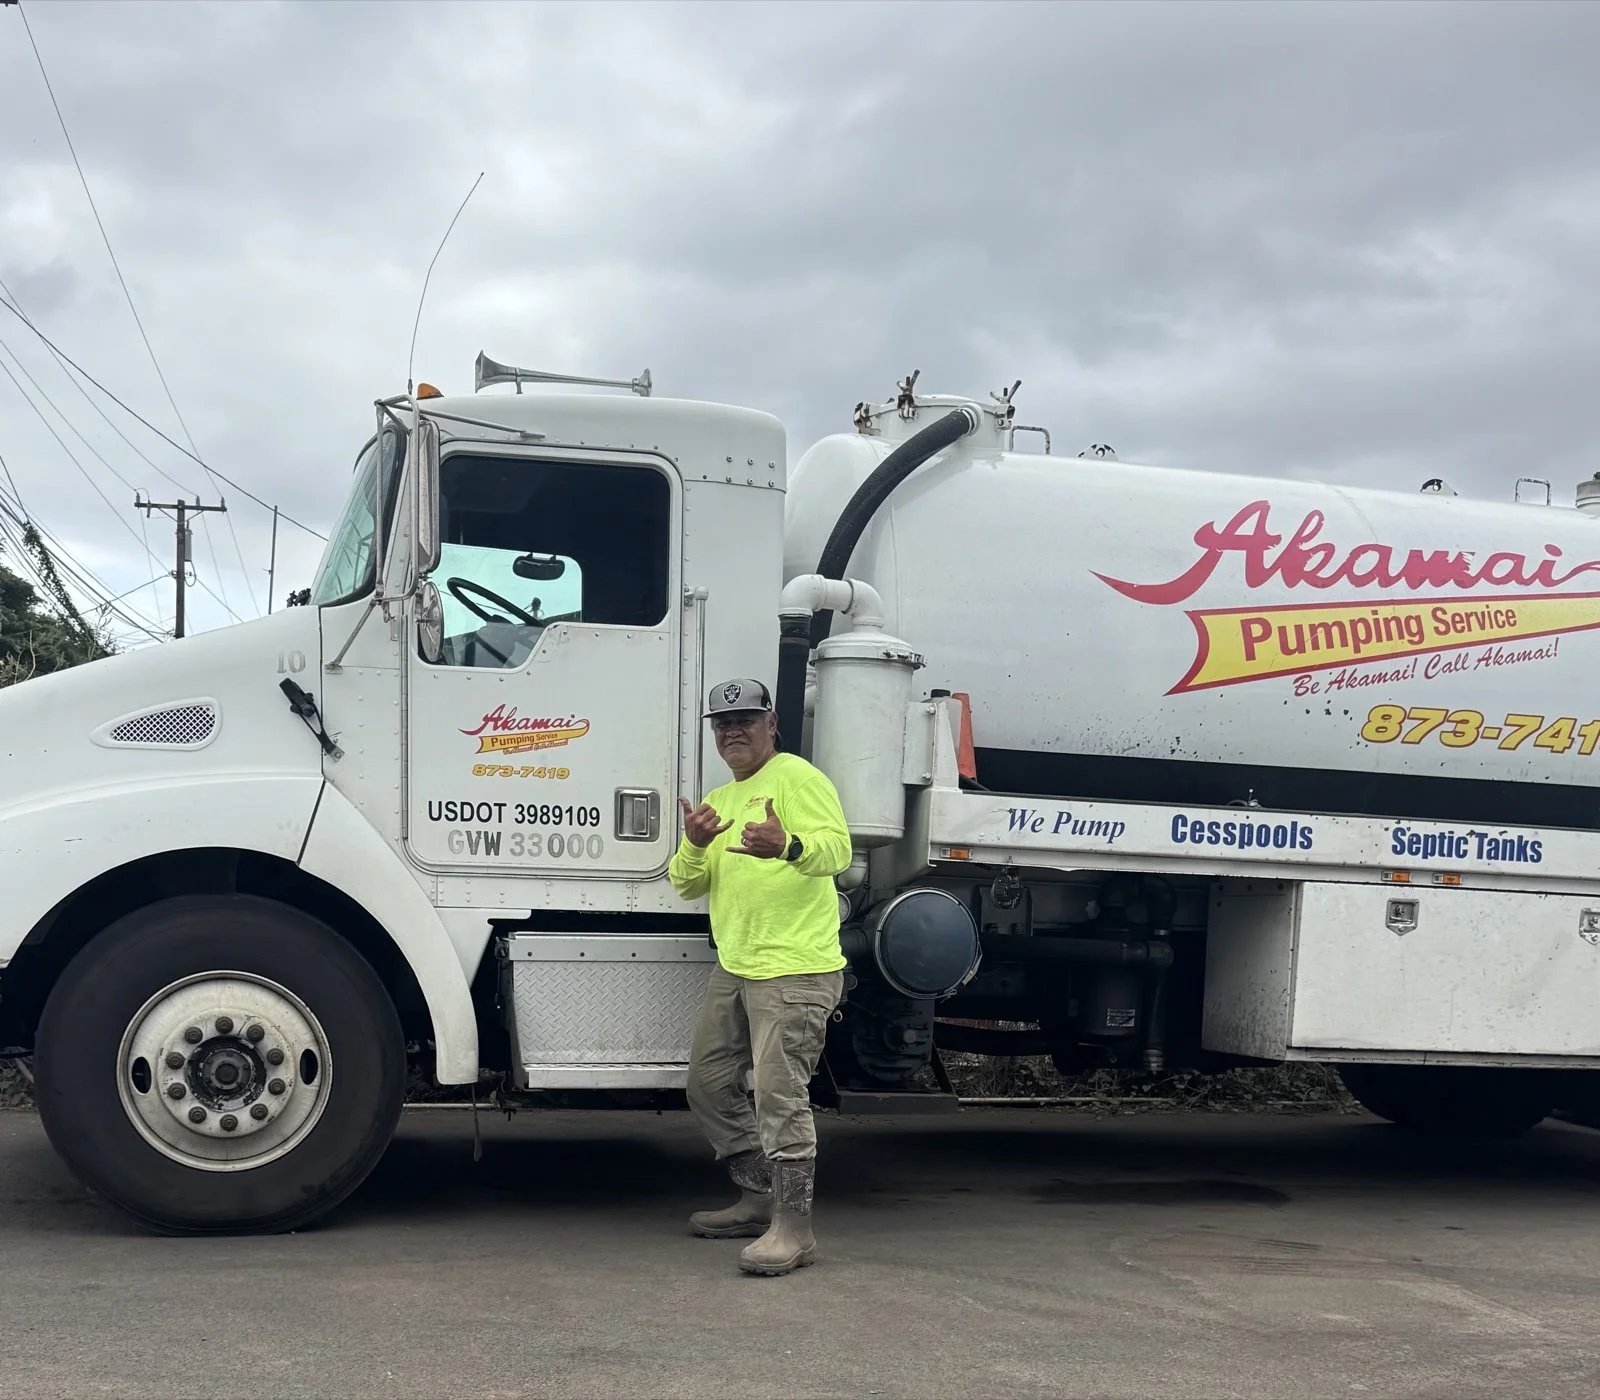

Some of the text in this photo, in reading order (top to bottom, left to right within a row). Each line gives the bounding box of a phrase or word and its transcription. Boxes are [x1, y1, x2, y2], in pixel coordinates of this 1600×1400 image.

[1089, 499, 1582, 605] Akamai
[1240, 604, 1518, 662] Pumping Service
[276, 650, 306, 674] 10
[1293, 637, 1560, 697] Be Akamai! Call Akamai!
[457, 703, 577, 736] Akamai
[1361, 704, 1600, 756] 873-741
[491, 734, 535, 747] Pumping
[536, 733, 559, 742] Service
[472, 764, 571, 780] 873-7419
[428, 800, 601, 827] USDOT 3989109
[447, 829, 605, 860] GVW 33000
[1007, 808, 1543, 864] We Pump Cesspools Septic Tanks
